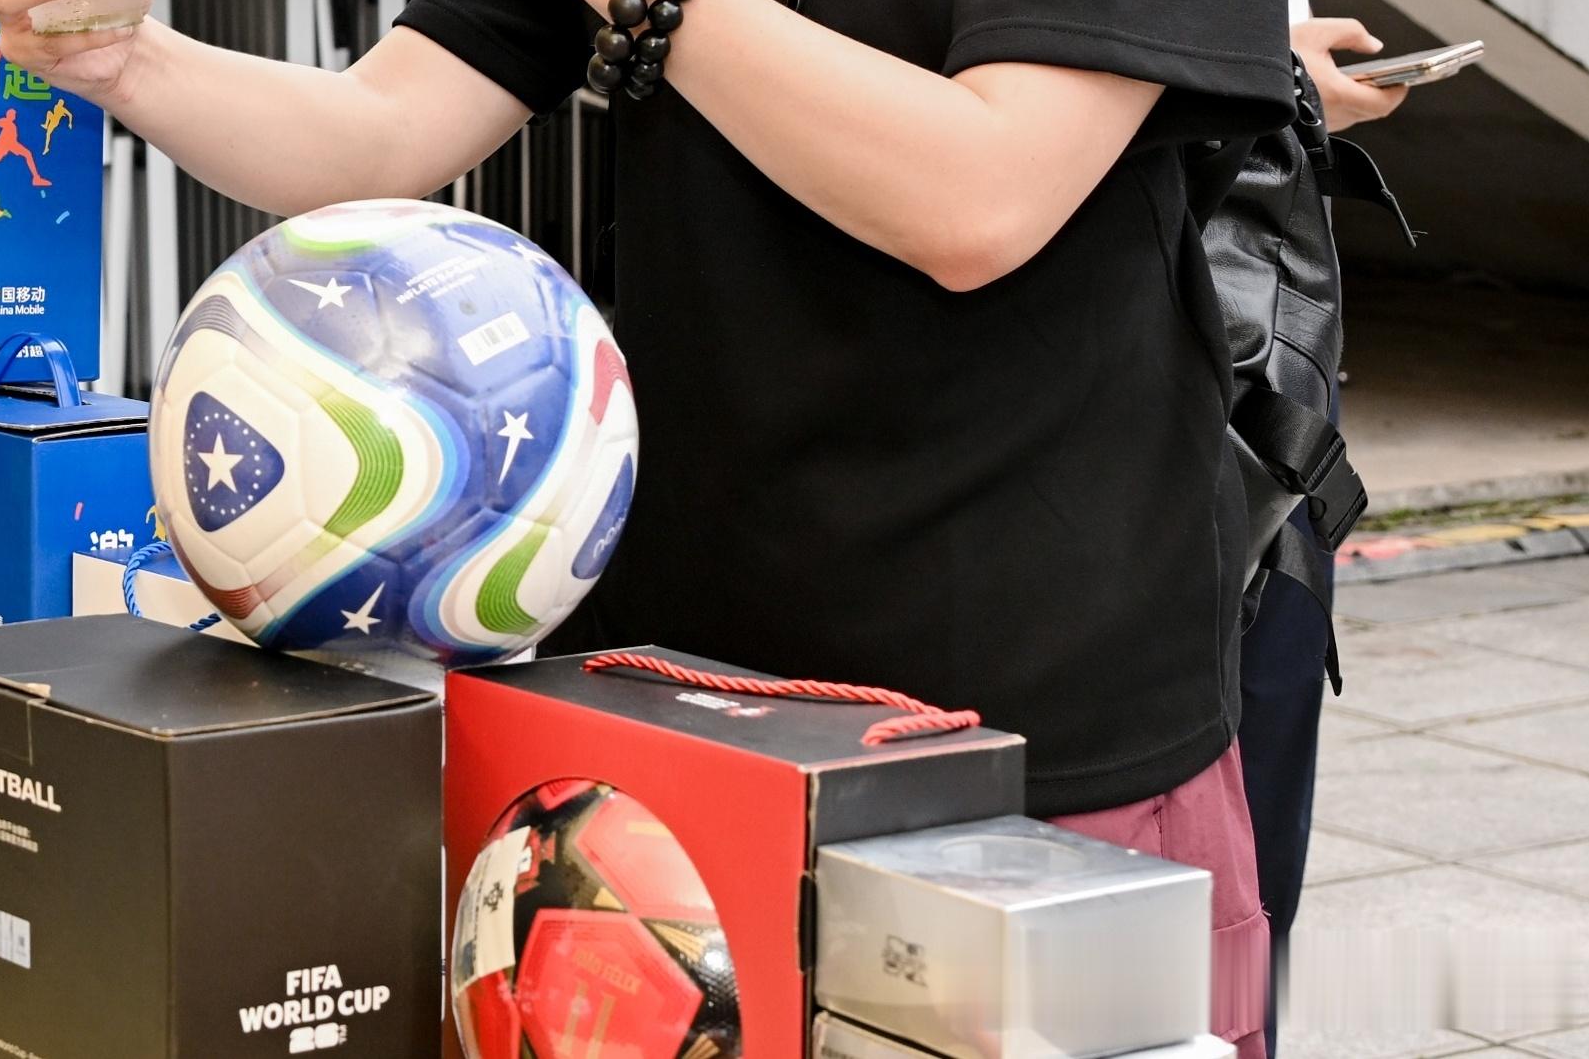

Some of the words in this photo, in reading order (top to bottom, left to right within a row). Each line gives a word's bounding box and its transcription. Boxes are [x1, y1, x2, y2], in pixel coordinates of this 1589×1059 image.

[15, 304, 45, 315] Mobile
[286, 964, 343, 996] FIFA
[239, 995, 335, 1033] WORLD
[337, 985, 391, 1017] CUP
